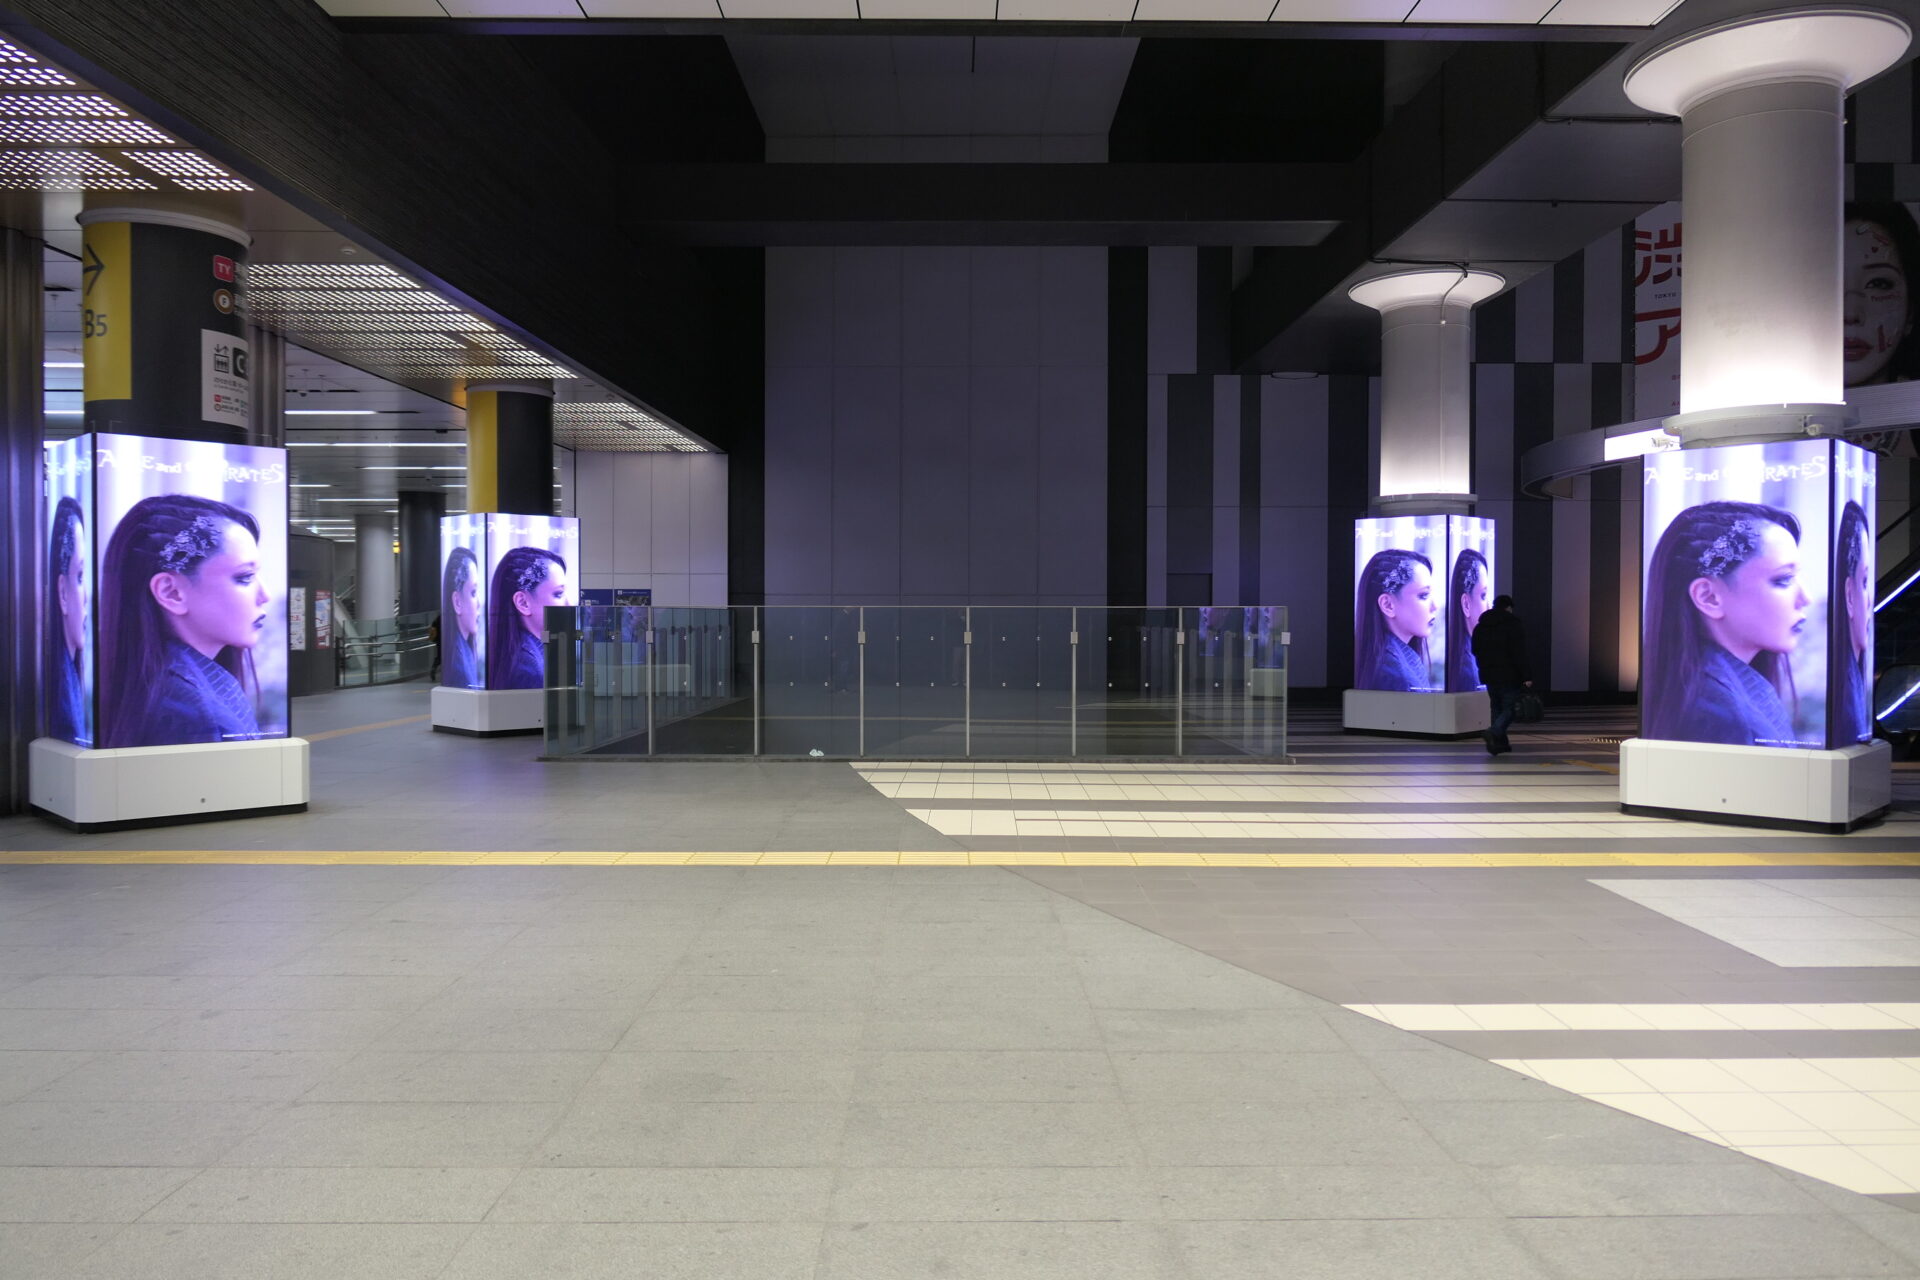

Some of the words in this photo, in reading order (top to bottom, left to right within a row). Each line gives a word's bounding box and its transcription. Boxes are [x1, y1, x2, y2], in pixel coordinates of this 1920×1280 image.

[216, 262, 232, 276] TY
[84, 308, 108, 339] B5
[155, 462, 182, 474] and
[1694, 469, 1720, 483] and
